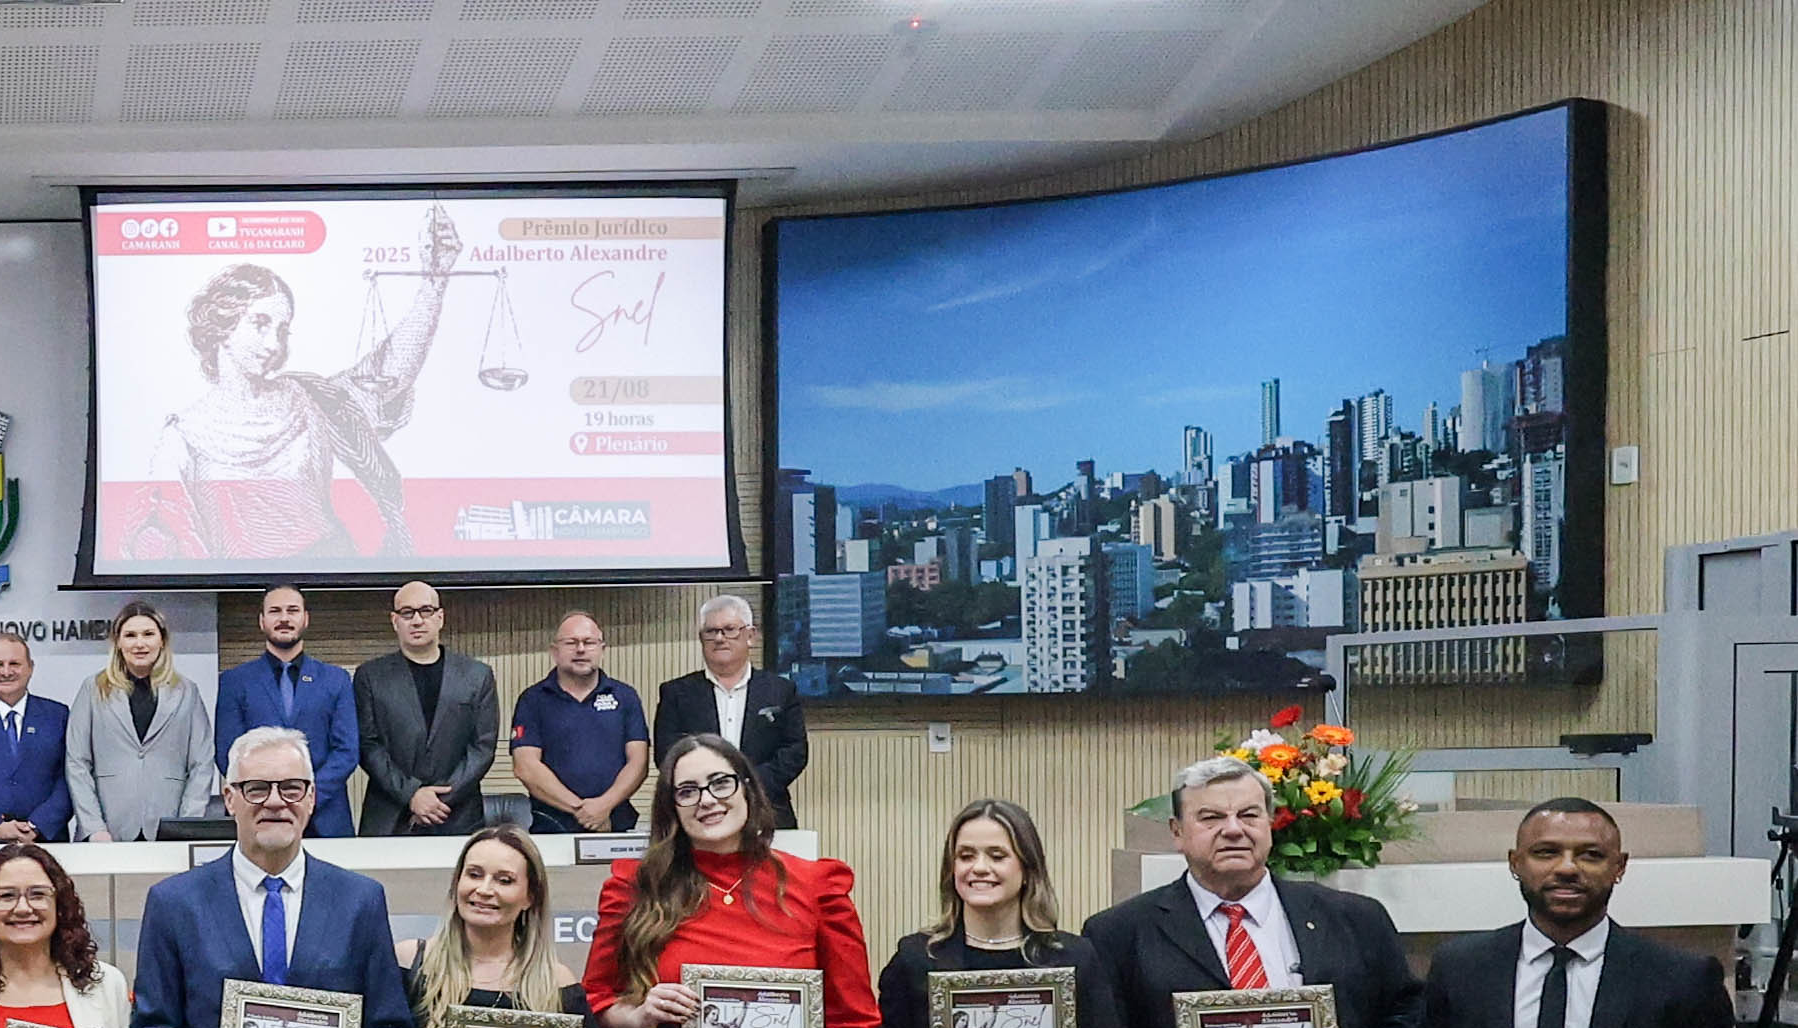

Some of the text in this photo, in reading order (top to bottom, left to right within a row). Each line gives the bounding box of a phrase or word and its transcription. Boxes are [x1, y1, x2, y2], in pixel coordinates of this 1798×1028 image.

[522, 219, 668, 239] Prêmio Jurídico
[362, 247, 411, 263] 2025
[469, 244, 668, 262] Adalberto Alexandre
[571, 270, 666, 353] Snel
[583, 379, 650, 403] 21/08
[584, 411, 654, 427] 19 horas
[595, 434, 668, 453] Plenário
[554, 504, 647, 525] CÂMARA
[52, 619, 112, 641] HAMB
